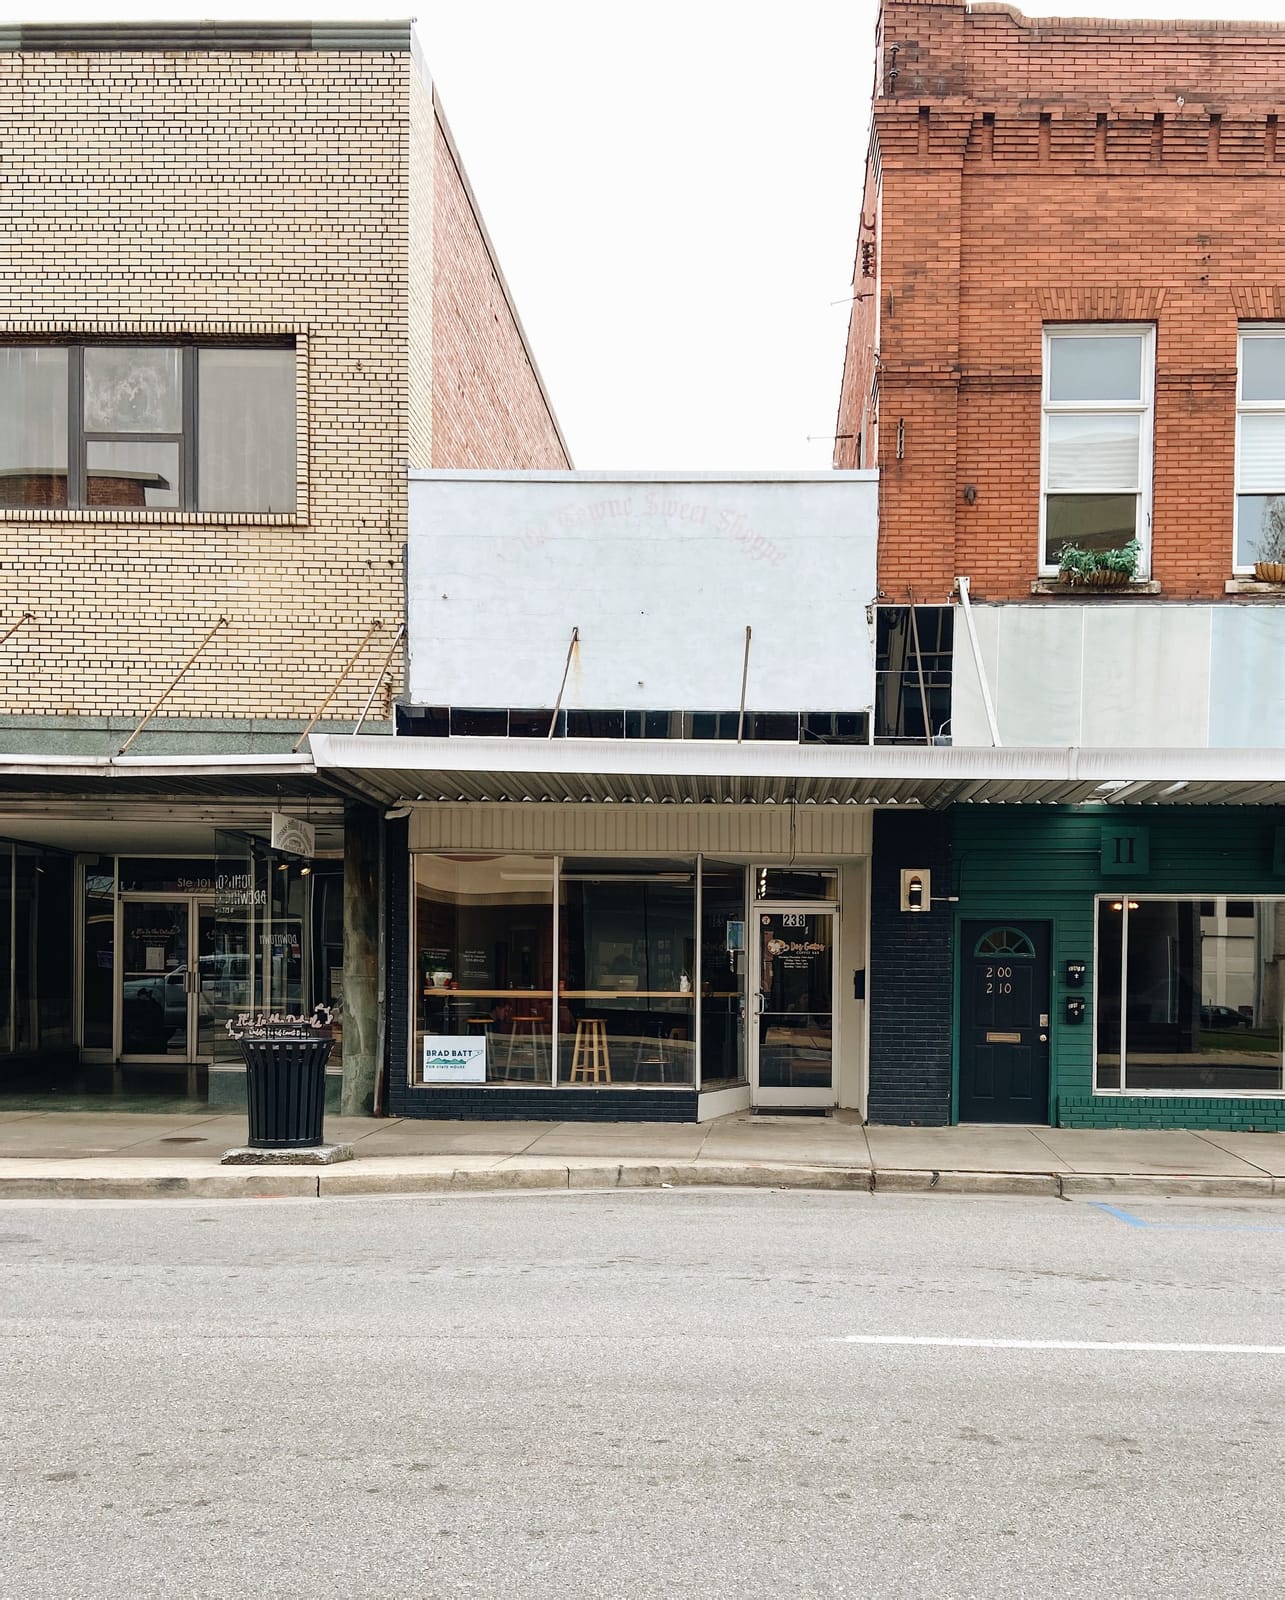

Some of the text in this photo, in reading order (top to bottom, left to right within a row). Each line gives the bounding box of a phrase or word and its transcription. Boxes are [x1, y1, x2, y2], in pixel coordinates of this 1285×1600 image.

[176, 877, 211, 889] Ste 101
[784, 914, 804, 926] 238
[985, 966, 1013, 979] 200
[985, 982, 1013, 995] 210
[426, 1049, 473, 1057] BRAD BATT
